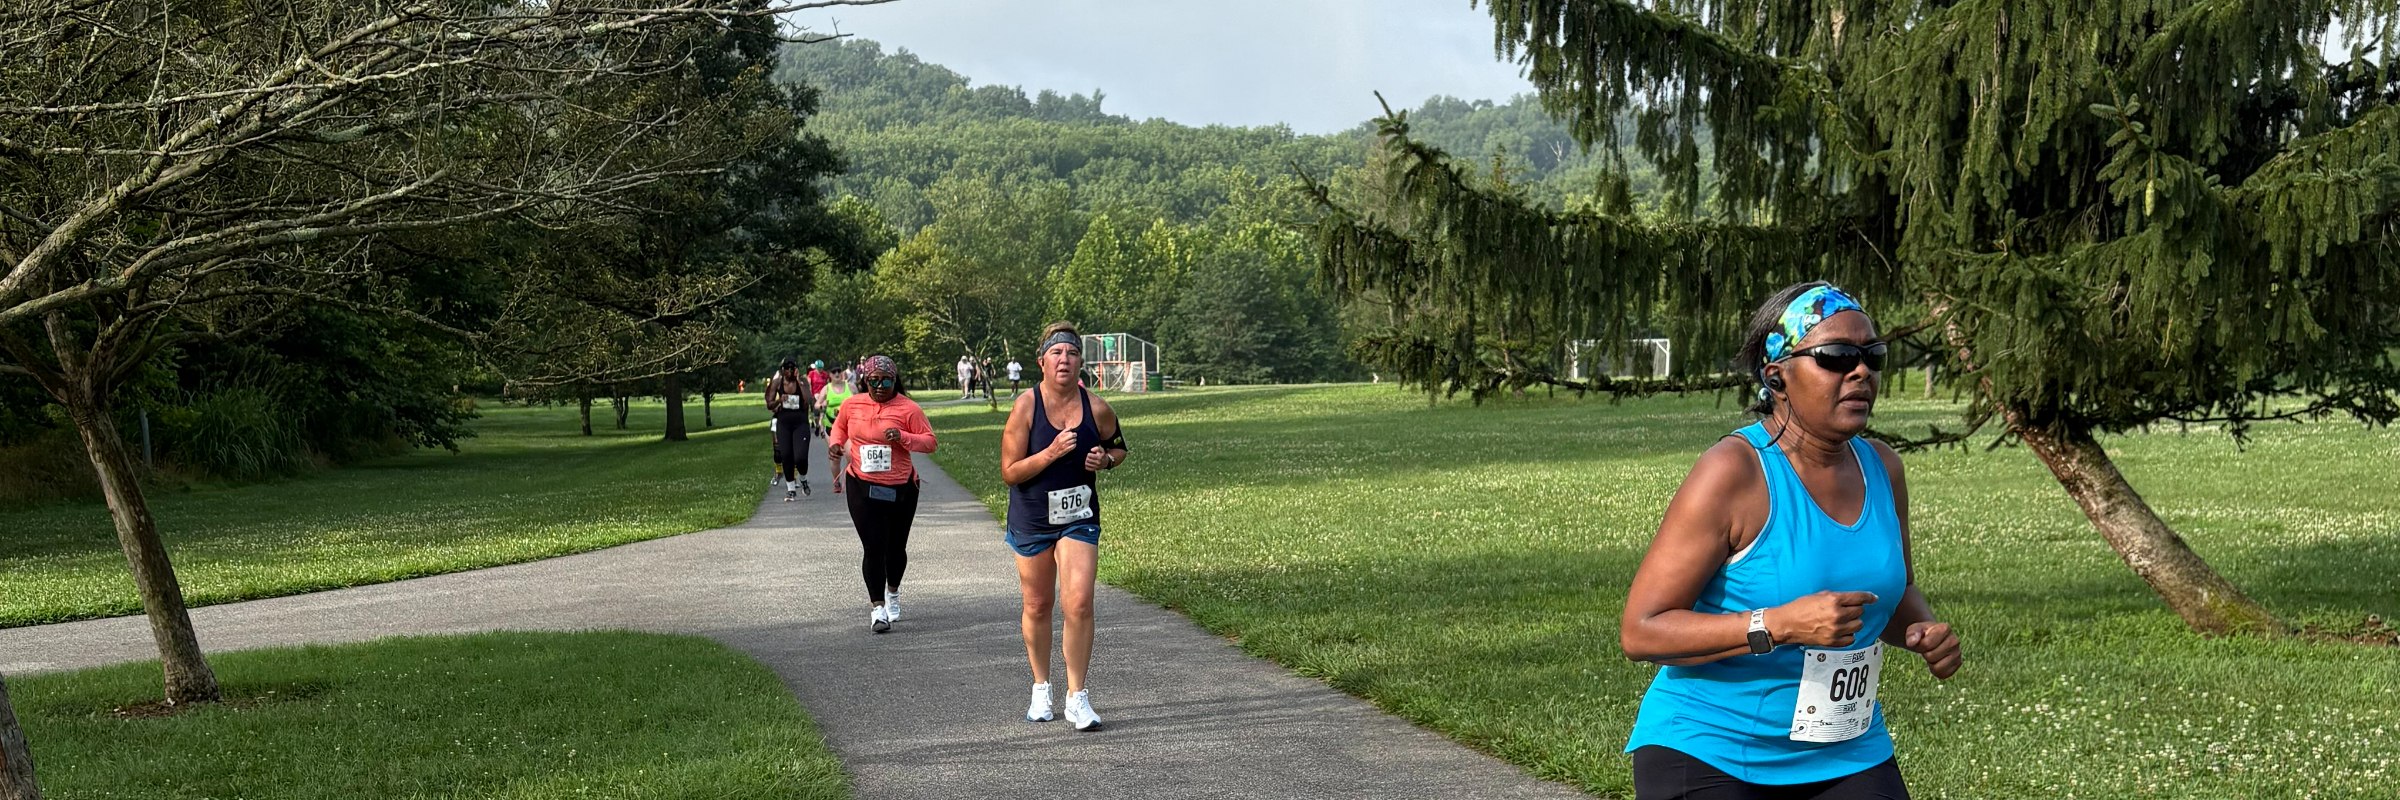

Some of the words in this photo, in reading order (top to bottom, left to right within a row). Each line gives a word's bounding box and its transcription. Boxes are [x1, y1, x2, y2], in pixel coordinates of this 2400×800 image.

[867, 449, 883, 460] 664
[1061, 493, 1082, 510] 676
[1829, 664, 1869, 702] 608
